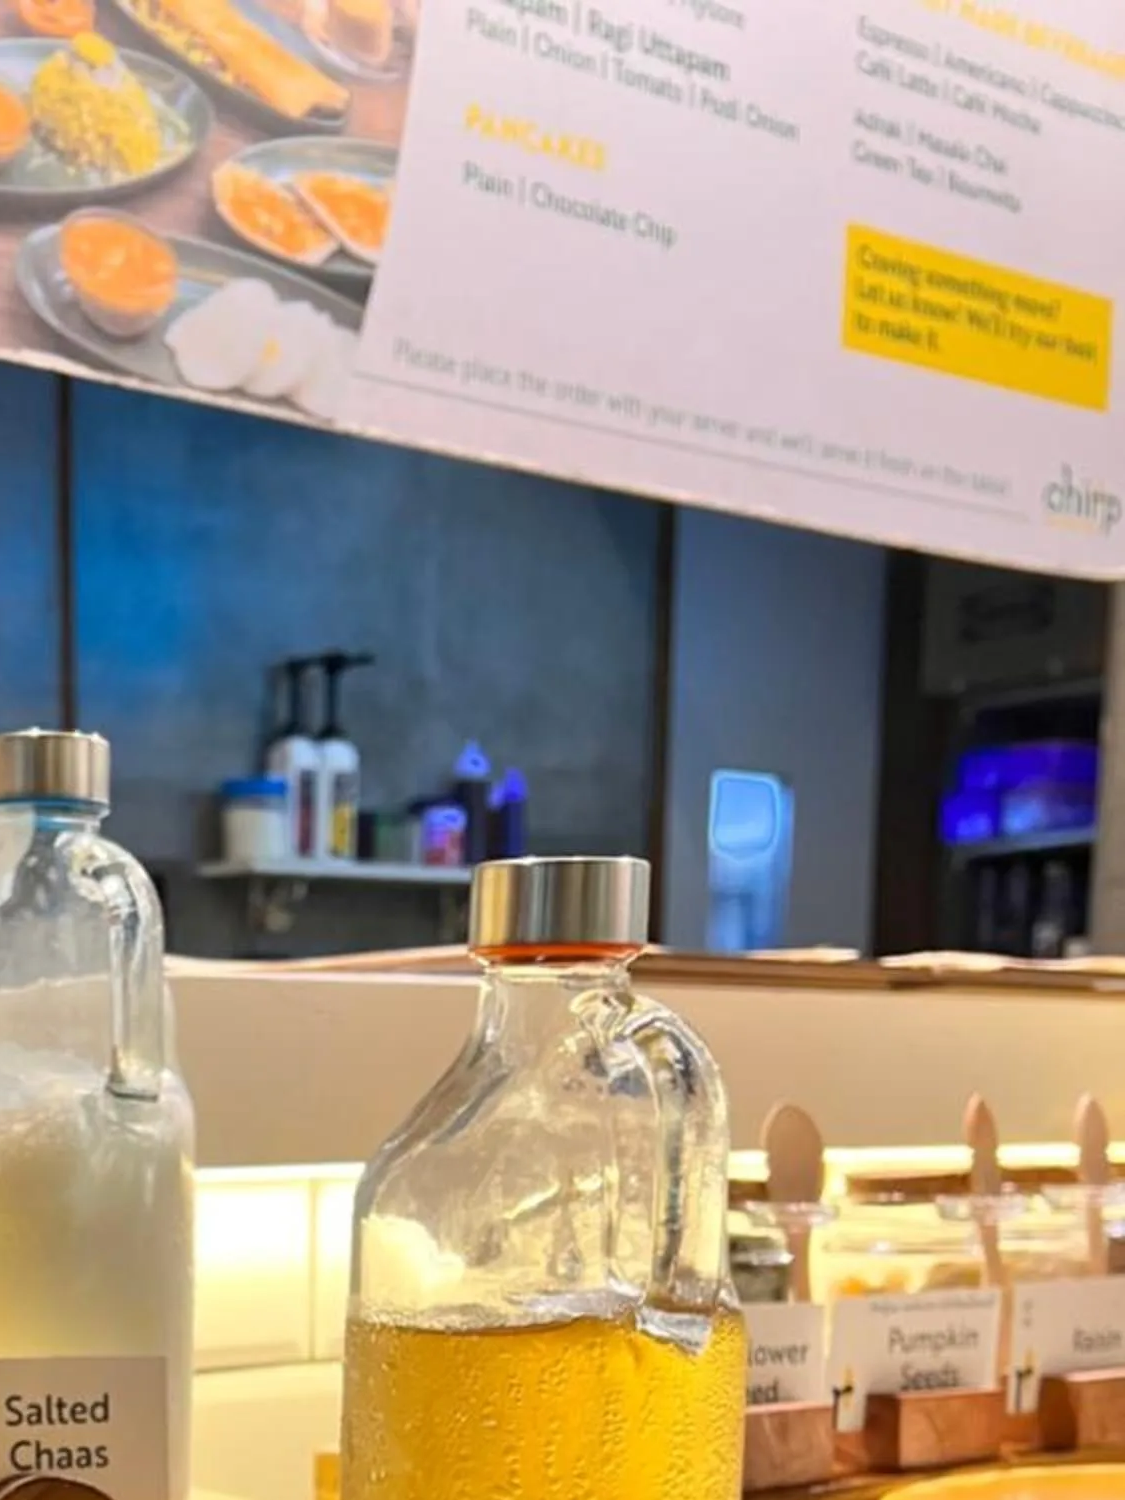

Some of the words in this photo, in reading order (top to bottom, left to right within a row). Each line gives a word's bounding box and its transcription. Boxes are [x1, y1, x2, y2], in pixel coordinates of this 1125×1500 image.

[467, 5, 517, 47] Plain
[534, 31, 597, 75] Onion
[613, 54, 683, 105] Tomato
[588, 8, 633, 52] Ragi
[638, 25, 730, 82] Uttapam
[463, 102, 607, 174] PANCAKES
[463, 159, 513, 199] Plain
[530, 181, 627, 232] Chocolate
[633, 210, 678, 250] Chip
[394, 336, 458, 373] Please
[463, 358, 512, 388] place
[517, 368, 547, 397] the
[555, 377, 602, 406] order
[607, 393, 641, 418] with
[1042, 461, 1124, 536] chirp
[747, 1341, 809, 1368] lower
[888, 1326, 979, 1356] Pumpkin
[5, 1393, 110, 1427] Salted
[900, 1364, 959, 1391] Seeds
[10, 1440, 109, 1472] Chaas
